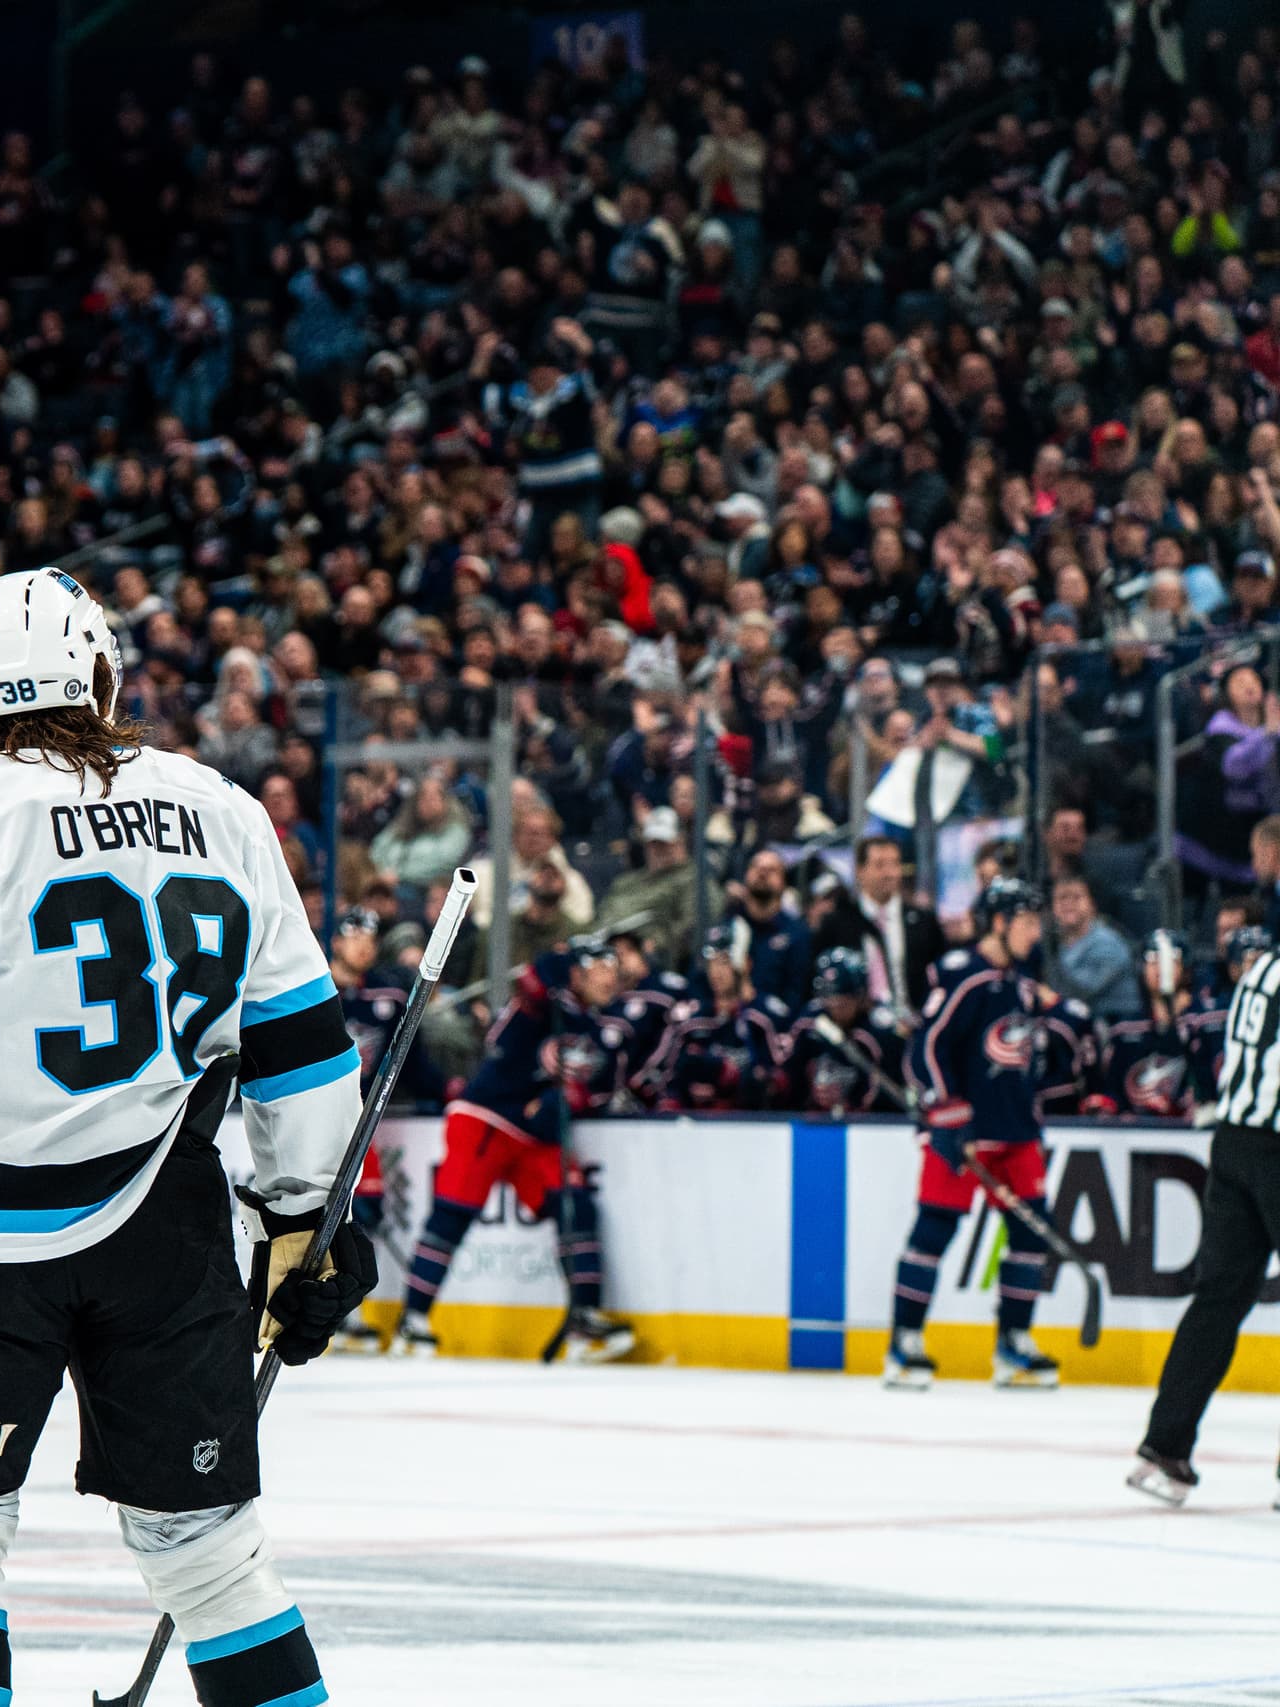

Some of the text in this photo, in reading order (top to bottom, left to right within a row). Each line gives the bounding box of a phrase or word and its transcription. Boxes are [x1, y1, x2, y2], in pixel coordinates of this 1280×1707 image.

[50, 798, 208, 860] O'BRIEN
[28, 871, 252, 1096] 38
[1235, 986, 1269, 1046] 19
